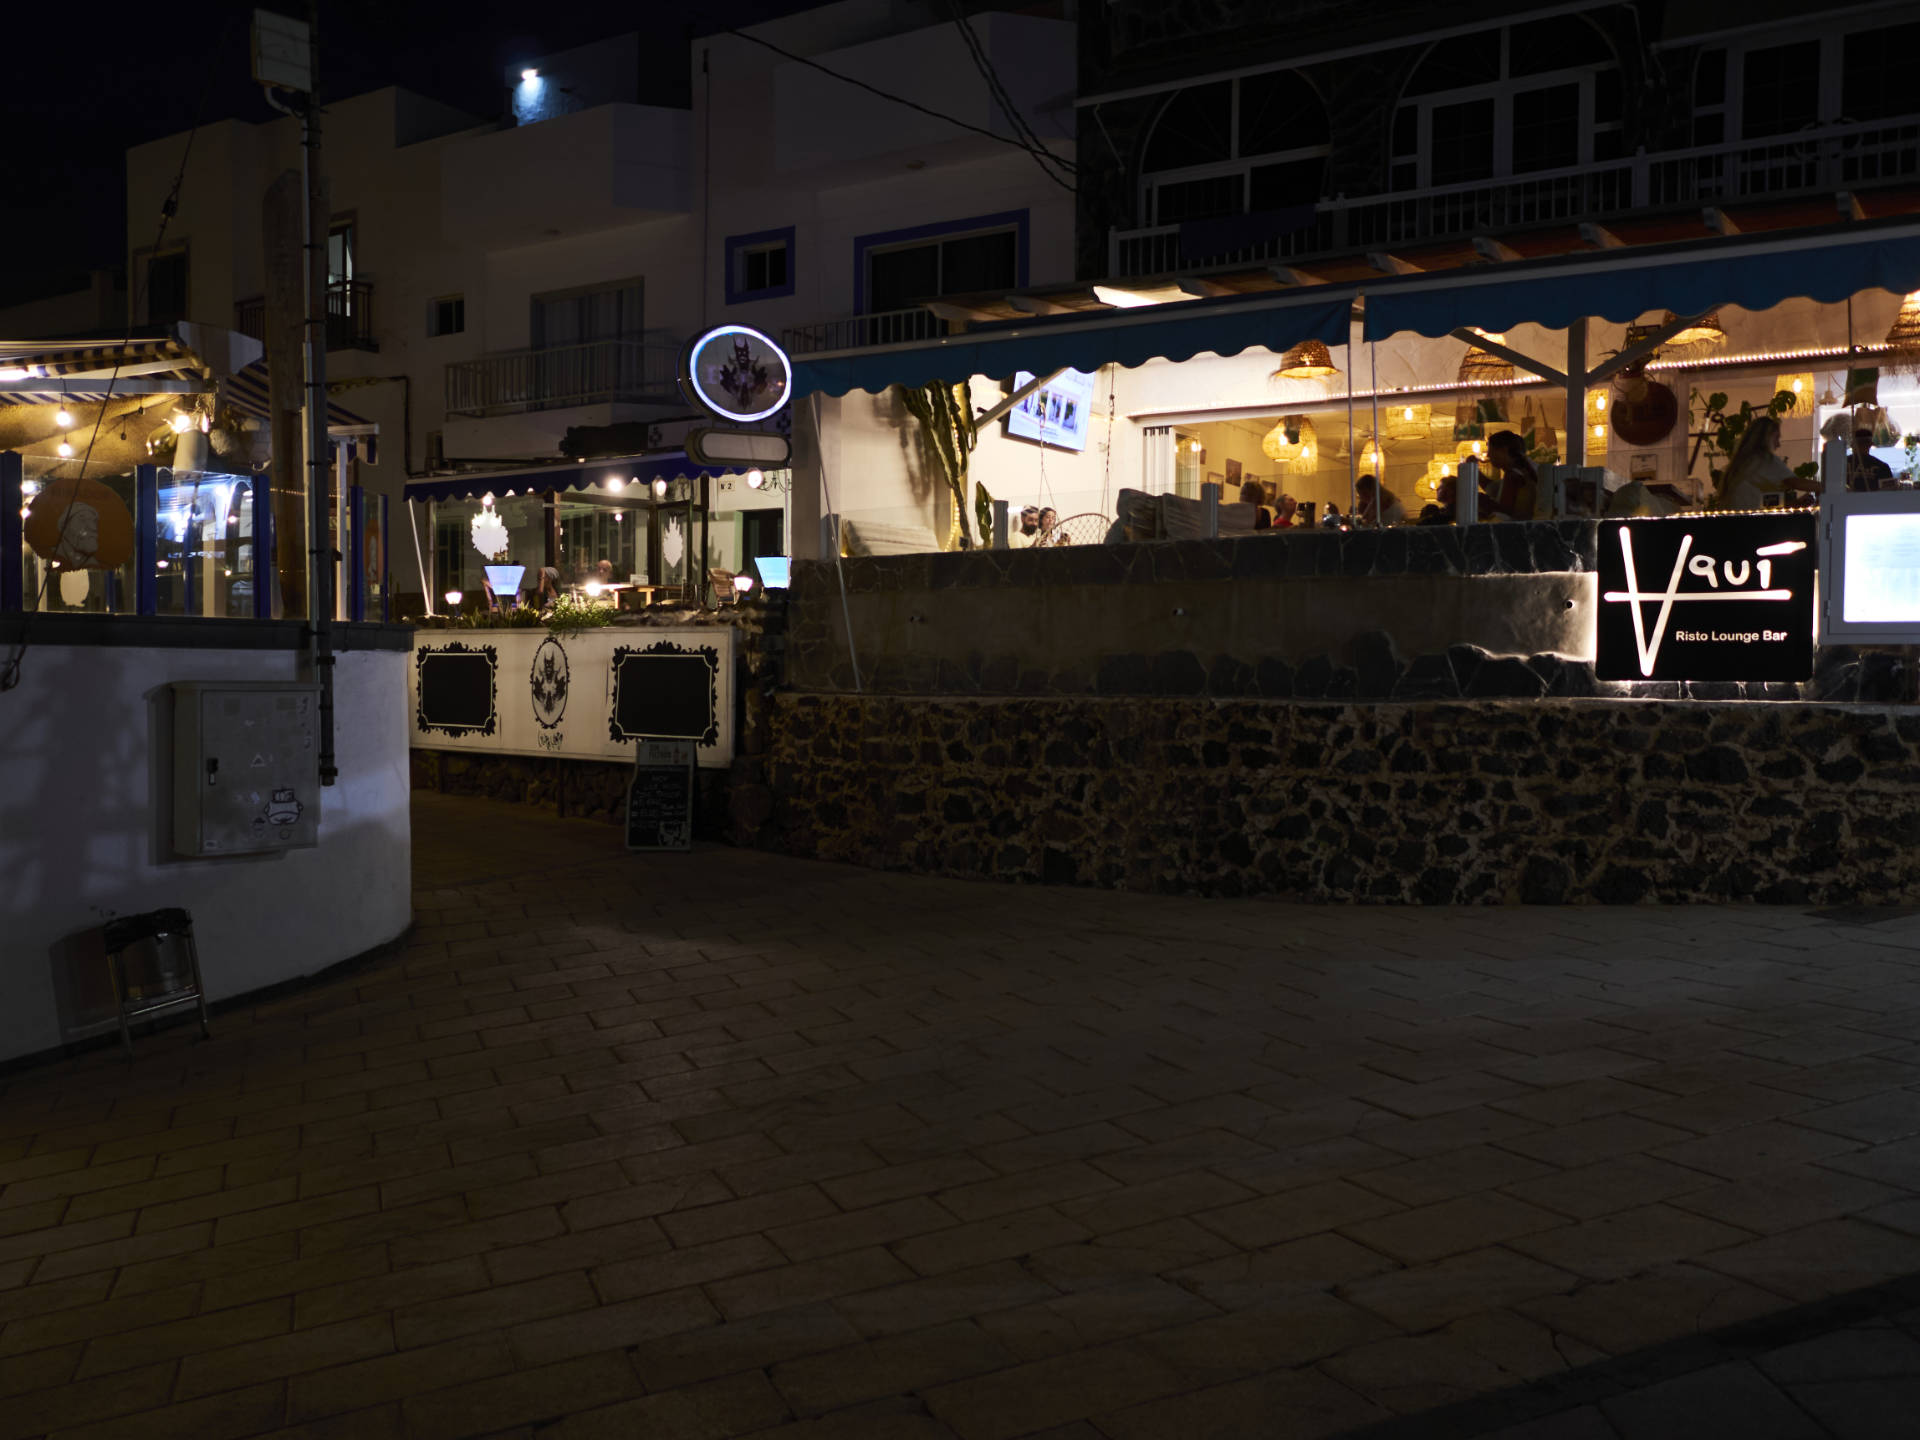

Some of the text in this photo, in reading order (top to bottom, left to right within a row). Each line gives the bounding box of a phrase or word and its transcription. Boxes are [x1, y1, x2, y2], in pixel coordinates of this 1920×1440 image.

[1675, 630, 1788, 643] Risto Lounge Bar
